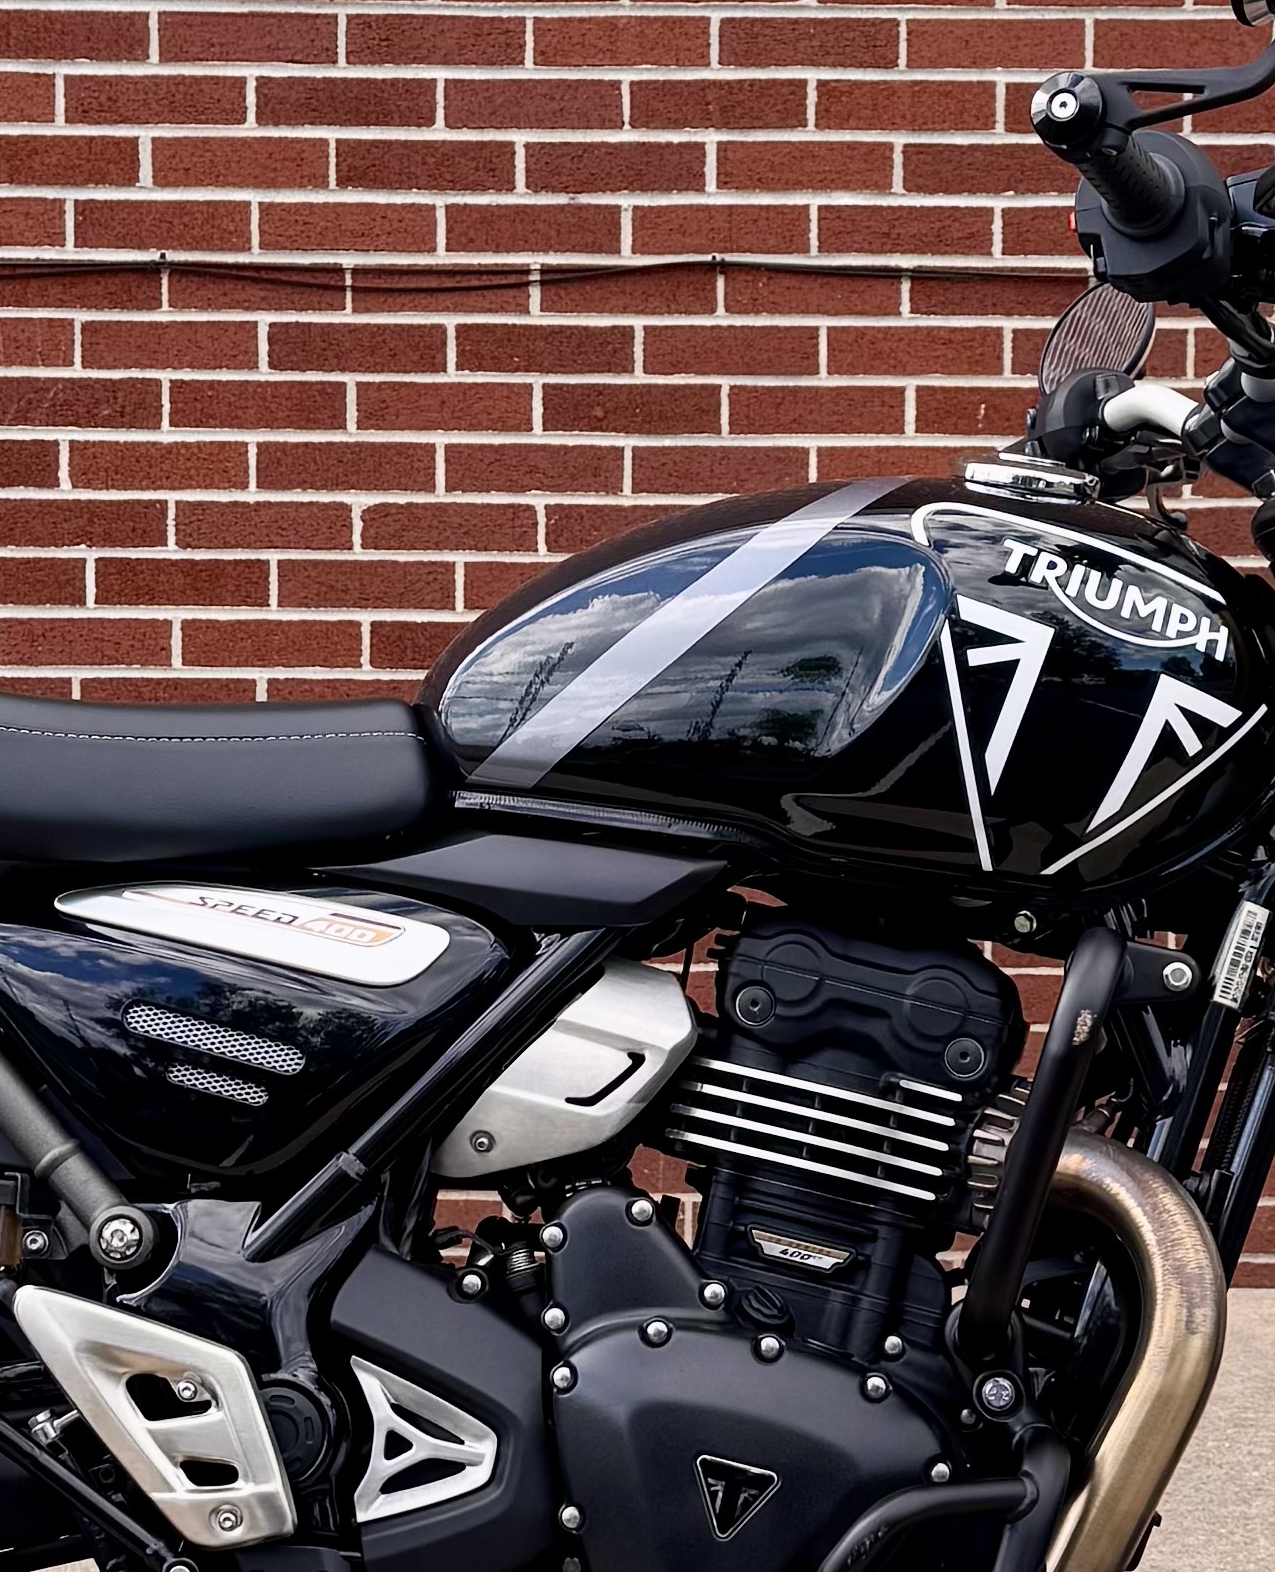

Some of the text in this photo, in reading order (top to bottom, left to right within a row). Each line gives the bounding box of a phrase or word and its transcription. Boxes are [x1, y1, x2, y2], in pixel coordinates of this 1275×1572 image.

[1003, 538, 1229, 662] TRIUMPH
[191, 896, 377, 943] SPEED 400
